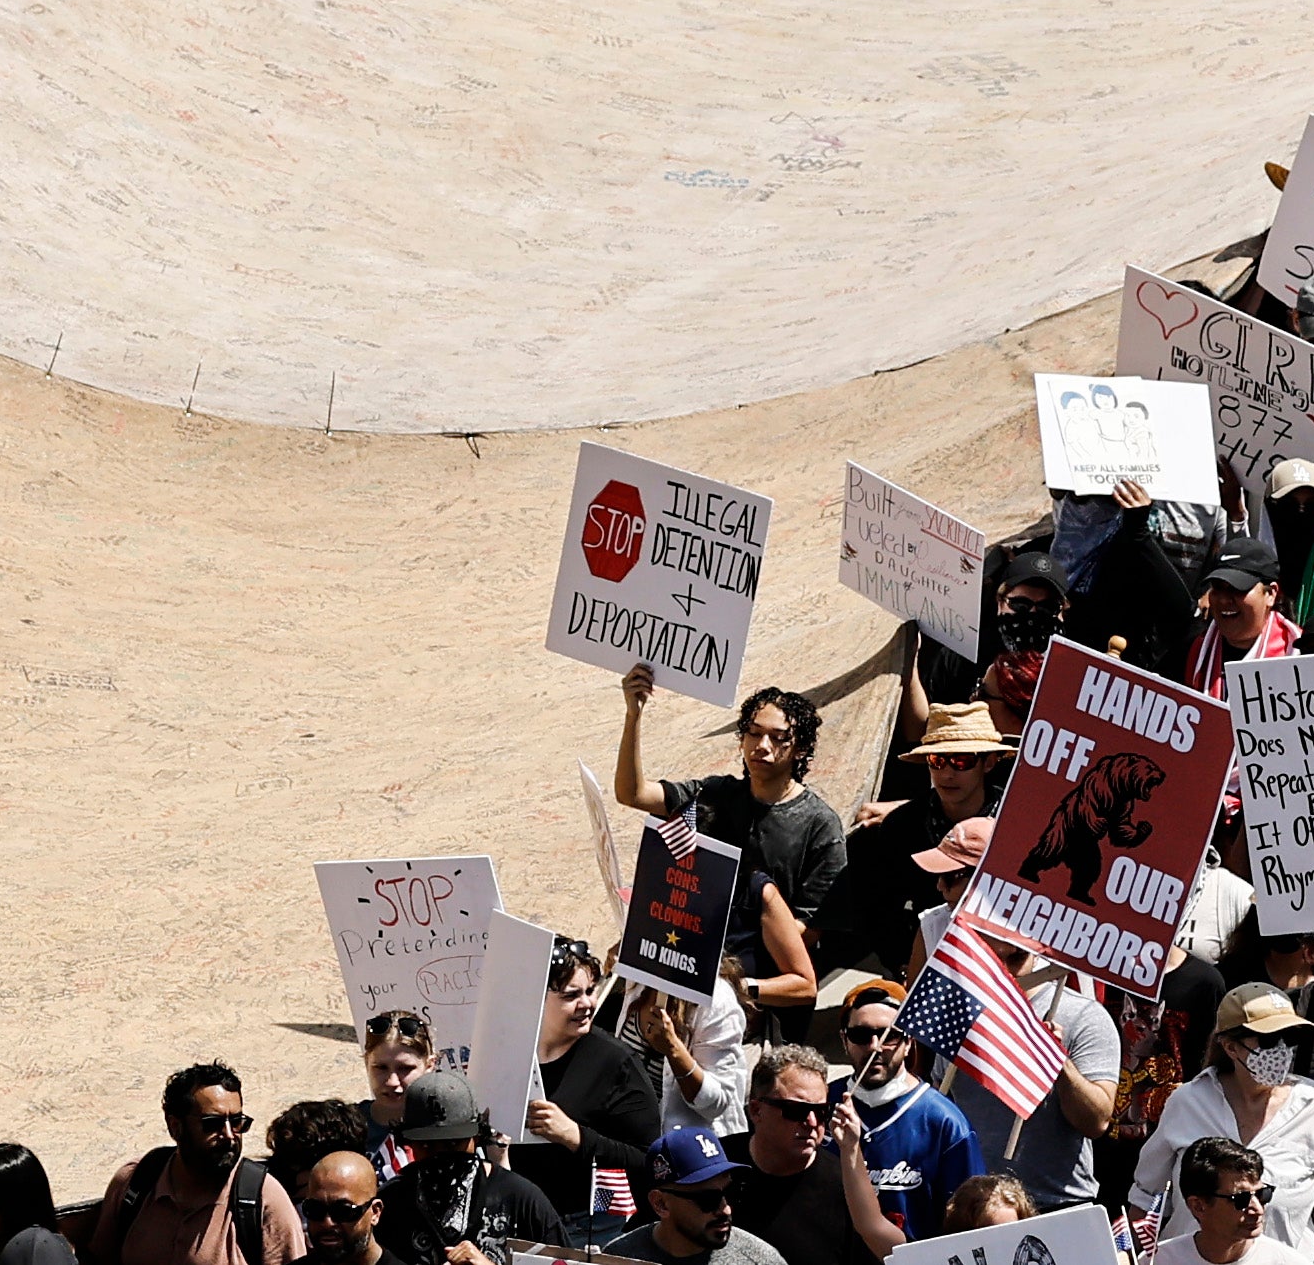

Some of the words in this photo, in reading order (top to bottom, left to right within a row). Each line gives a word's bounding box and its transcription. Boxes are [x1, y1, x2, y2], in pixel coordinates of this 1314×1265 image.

[585, 504, 644, 555] STOP
[662, 480, 761, 547] ILLEGAL
[652, 526, 761, 600] DETENTION
[568, 592, 728, 683] DEPORTATION
[1076, 667, 1200, 754] HANDS
[1023, 720, 1095, 782] OFF
[1238, 728, 1284, 758] Does
[1248, 759, 1314, 809] Repeat
[1250, 821, 1281, 850] It
[375, 874, 453, 927] STOP
[1103, 856, 1185, 925] OUR
[968, 873, 1164, 979] NEIGHBORS
[640, 939, 656, 959] NO
[659, 944, 698, 975] KINGS.
[361, 980, 398, 1009] your
